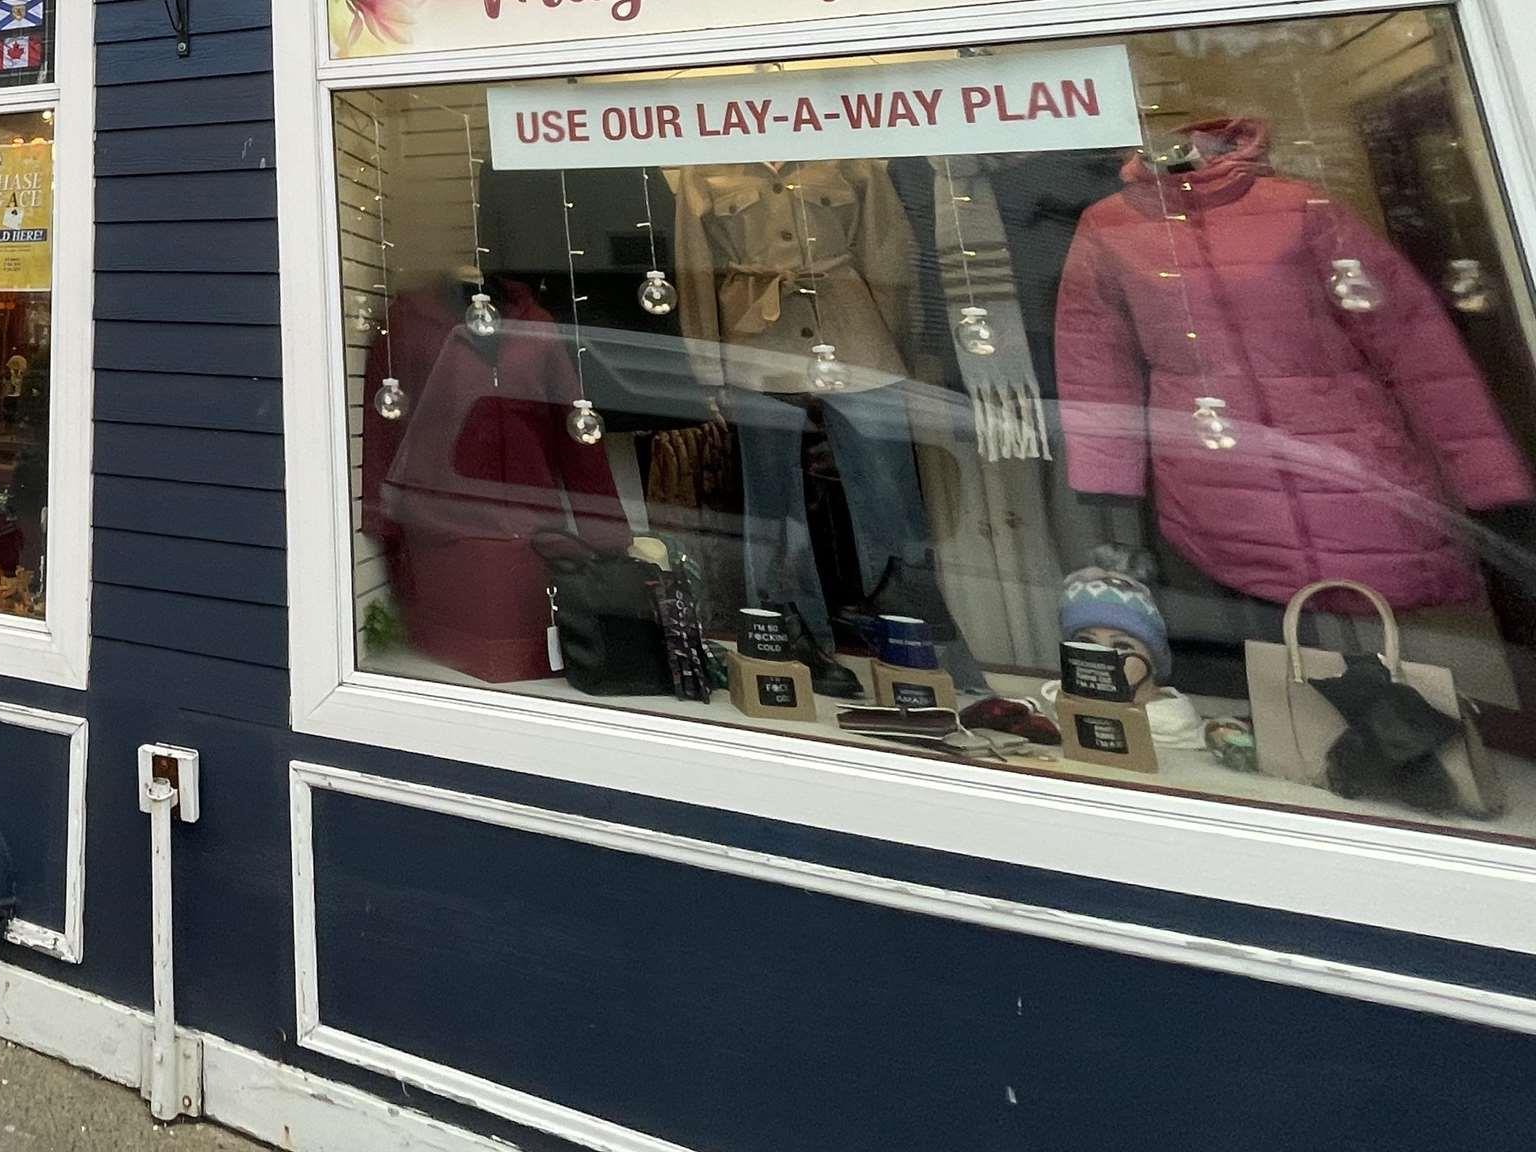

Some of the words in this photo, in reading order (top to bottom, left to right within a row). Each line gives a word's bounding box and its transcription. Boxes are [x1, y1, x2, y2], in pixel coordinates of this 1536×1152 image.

[516, 109, 590, 145] USE
[602, 104, 681, 141] OUR
[697, 89, 944, 137] LAY-A-WAY
[963, 78, 1101, 125] PLAN
